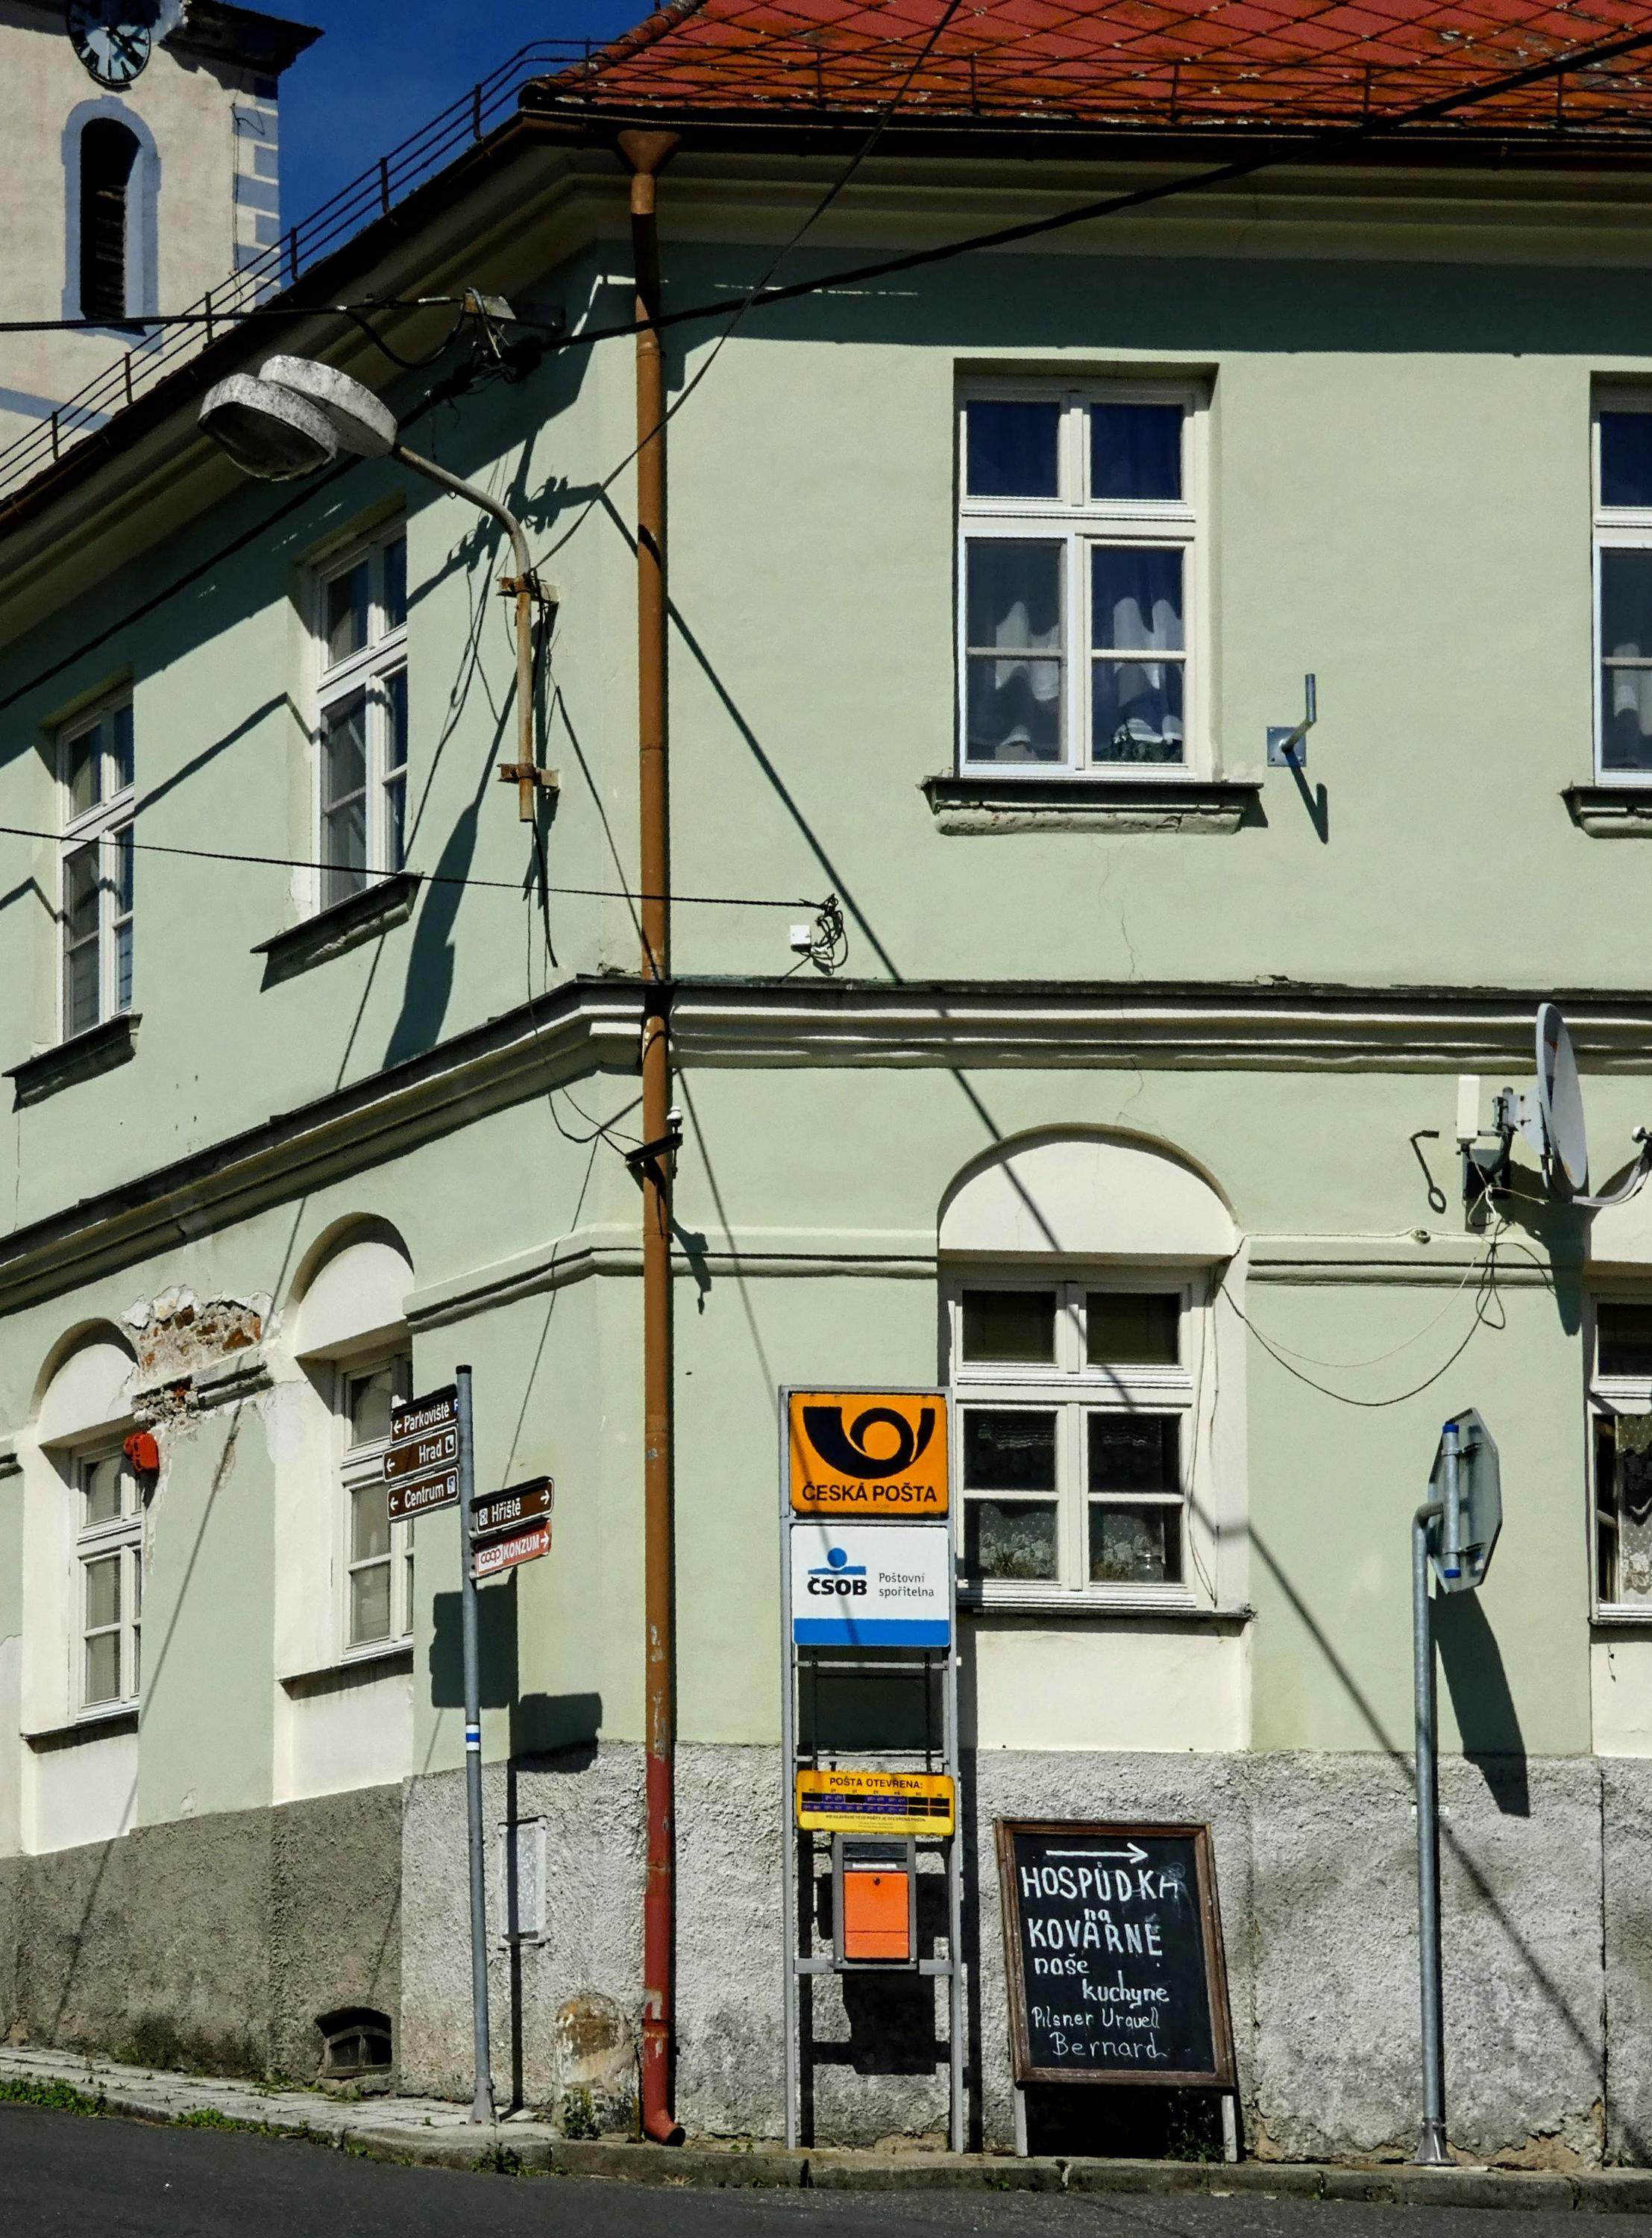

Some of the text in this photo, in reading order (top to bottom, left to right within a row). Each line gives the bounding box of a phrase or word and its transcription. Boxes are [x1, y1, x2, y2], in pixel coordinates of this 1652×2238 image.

[403, 1402, 450, 1432] Parkoviště
[418, 1439, 442, 1464] Hrad
[404, 1483, 445, 1508] Centrum
[802, 1481, 938, 1502] ČESKÁ POŠTA
[491, 1497, 521, 1523] Hřiště
[503, 1534, 540, 1561] KONZUM
[807, 1576, 867, 1596] ČSOB
[879, 1573, 926, 1583] Poštovní
[879, 1586, 935, 1599] spořitelna
[829, 1775, 863, 1786] POŠTA
[1084, 1908, 1111, 1923] na
[1034, 1954, 1090, 1975] naše
[1031, 2006, 1161, 2028] Pilsner Urquell
[1049, 2032, 1168, 2057] Bernard
